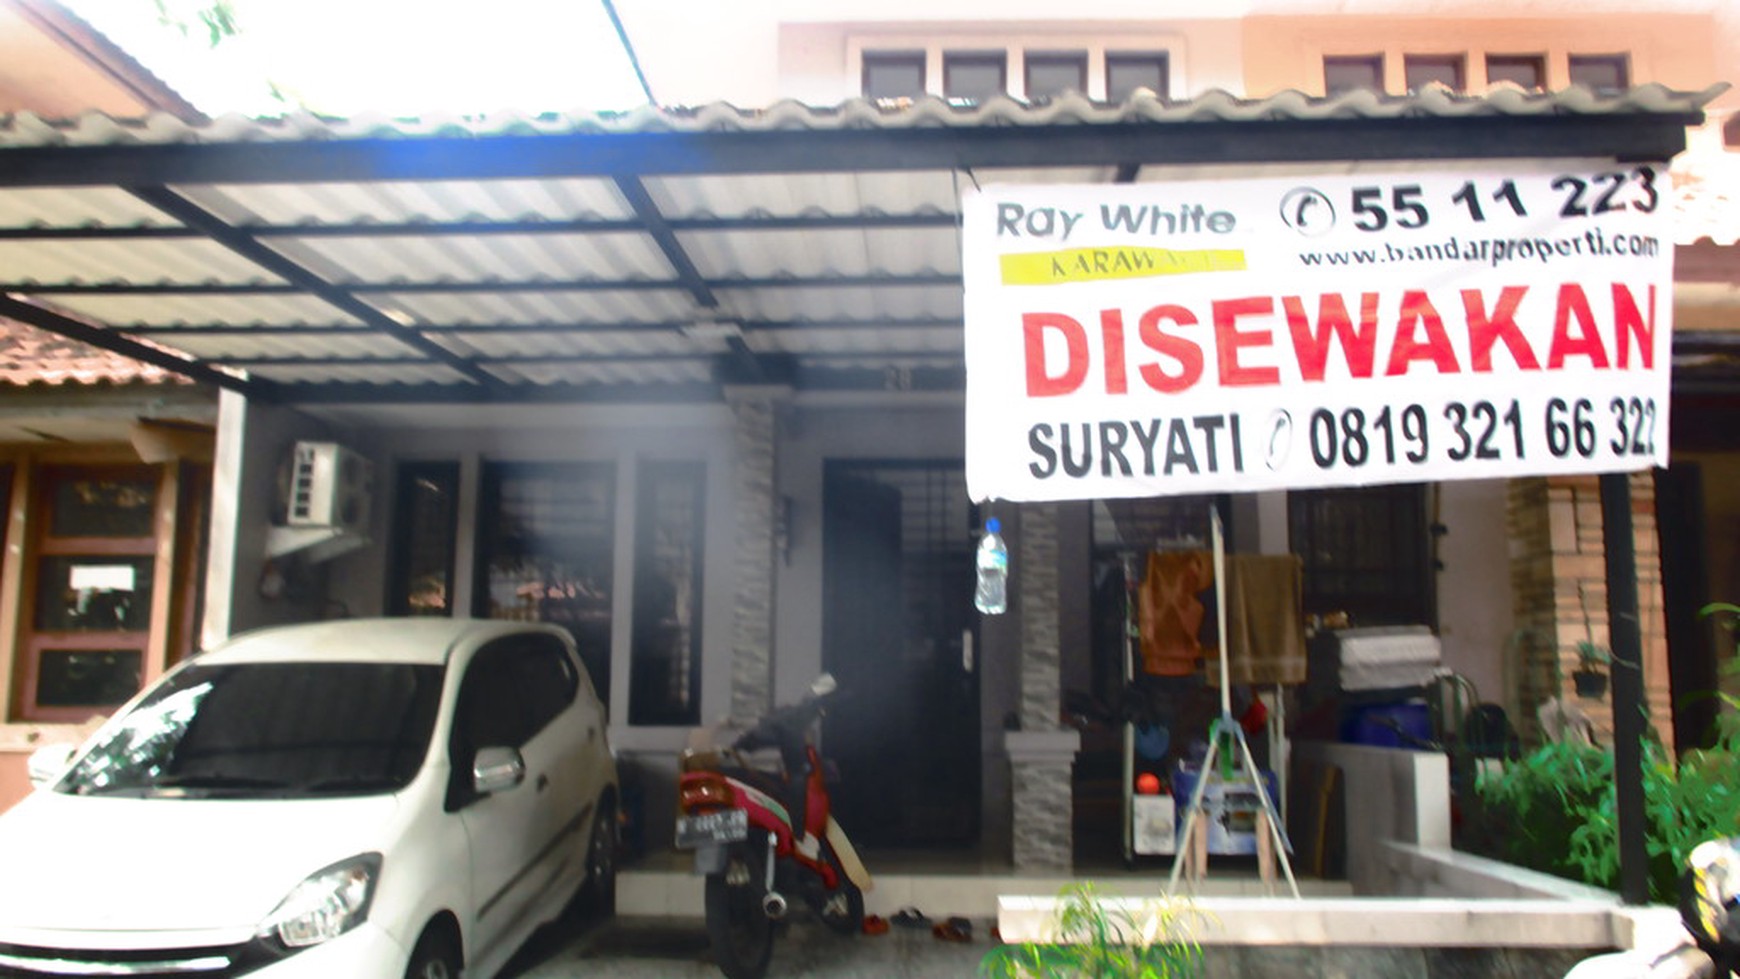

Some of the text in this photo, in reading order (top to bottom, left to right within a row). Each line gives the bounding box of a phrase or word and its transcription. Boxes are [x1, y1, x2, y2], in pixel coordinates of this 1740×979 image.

[997, 202, 1237, 241] Ray White
[1351, 166, 1658, 232] 55 11 223
[1299, 227, 1659, 268] www.bandarproperti.com
[1021, 282, 1656, 398] DISEWAKAN
[1028, 396, 1656, 479] SURYATI 0819 321 66 322
